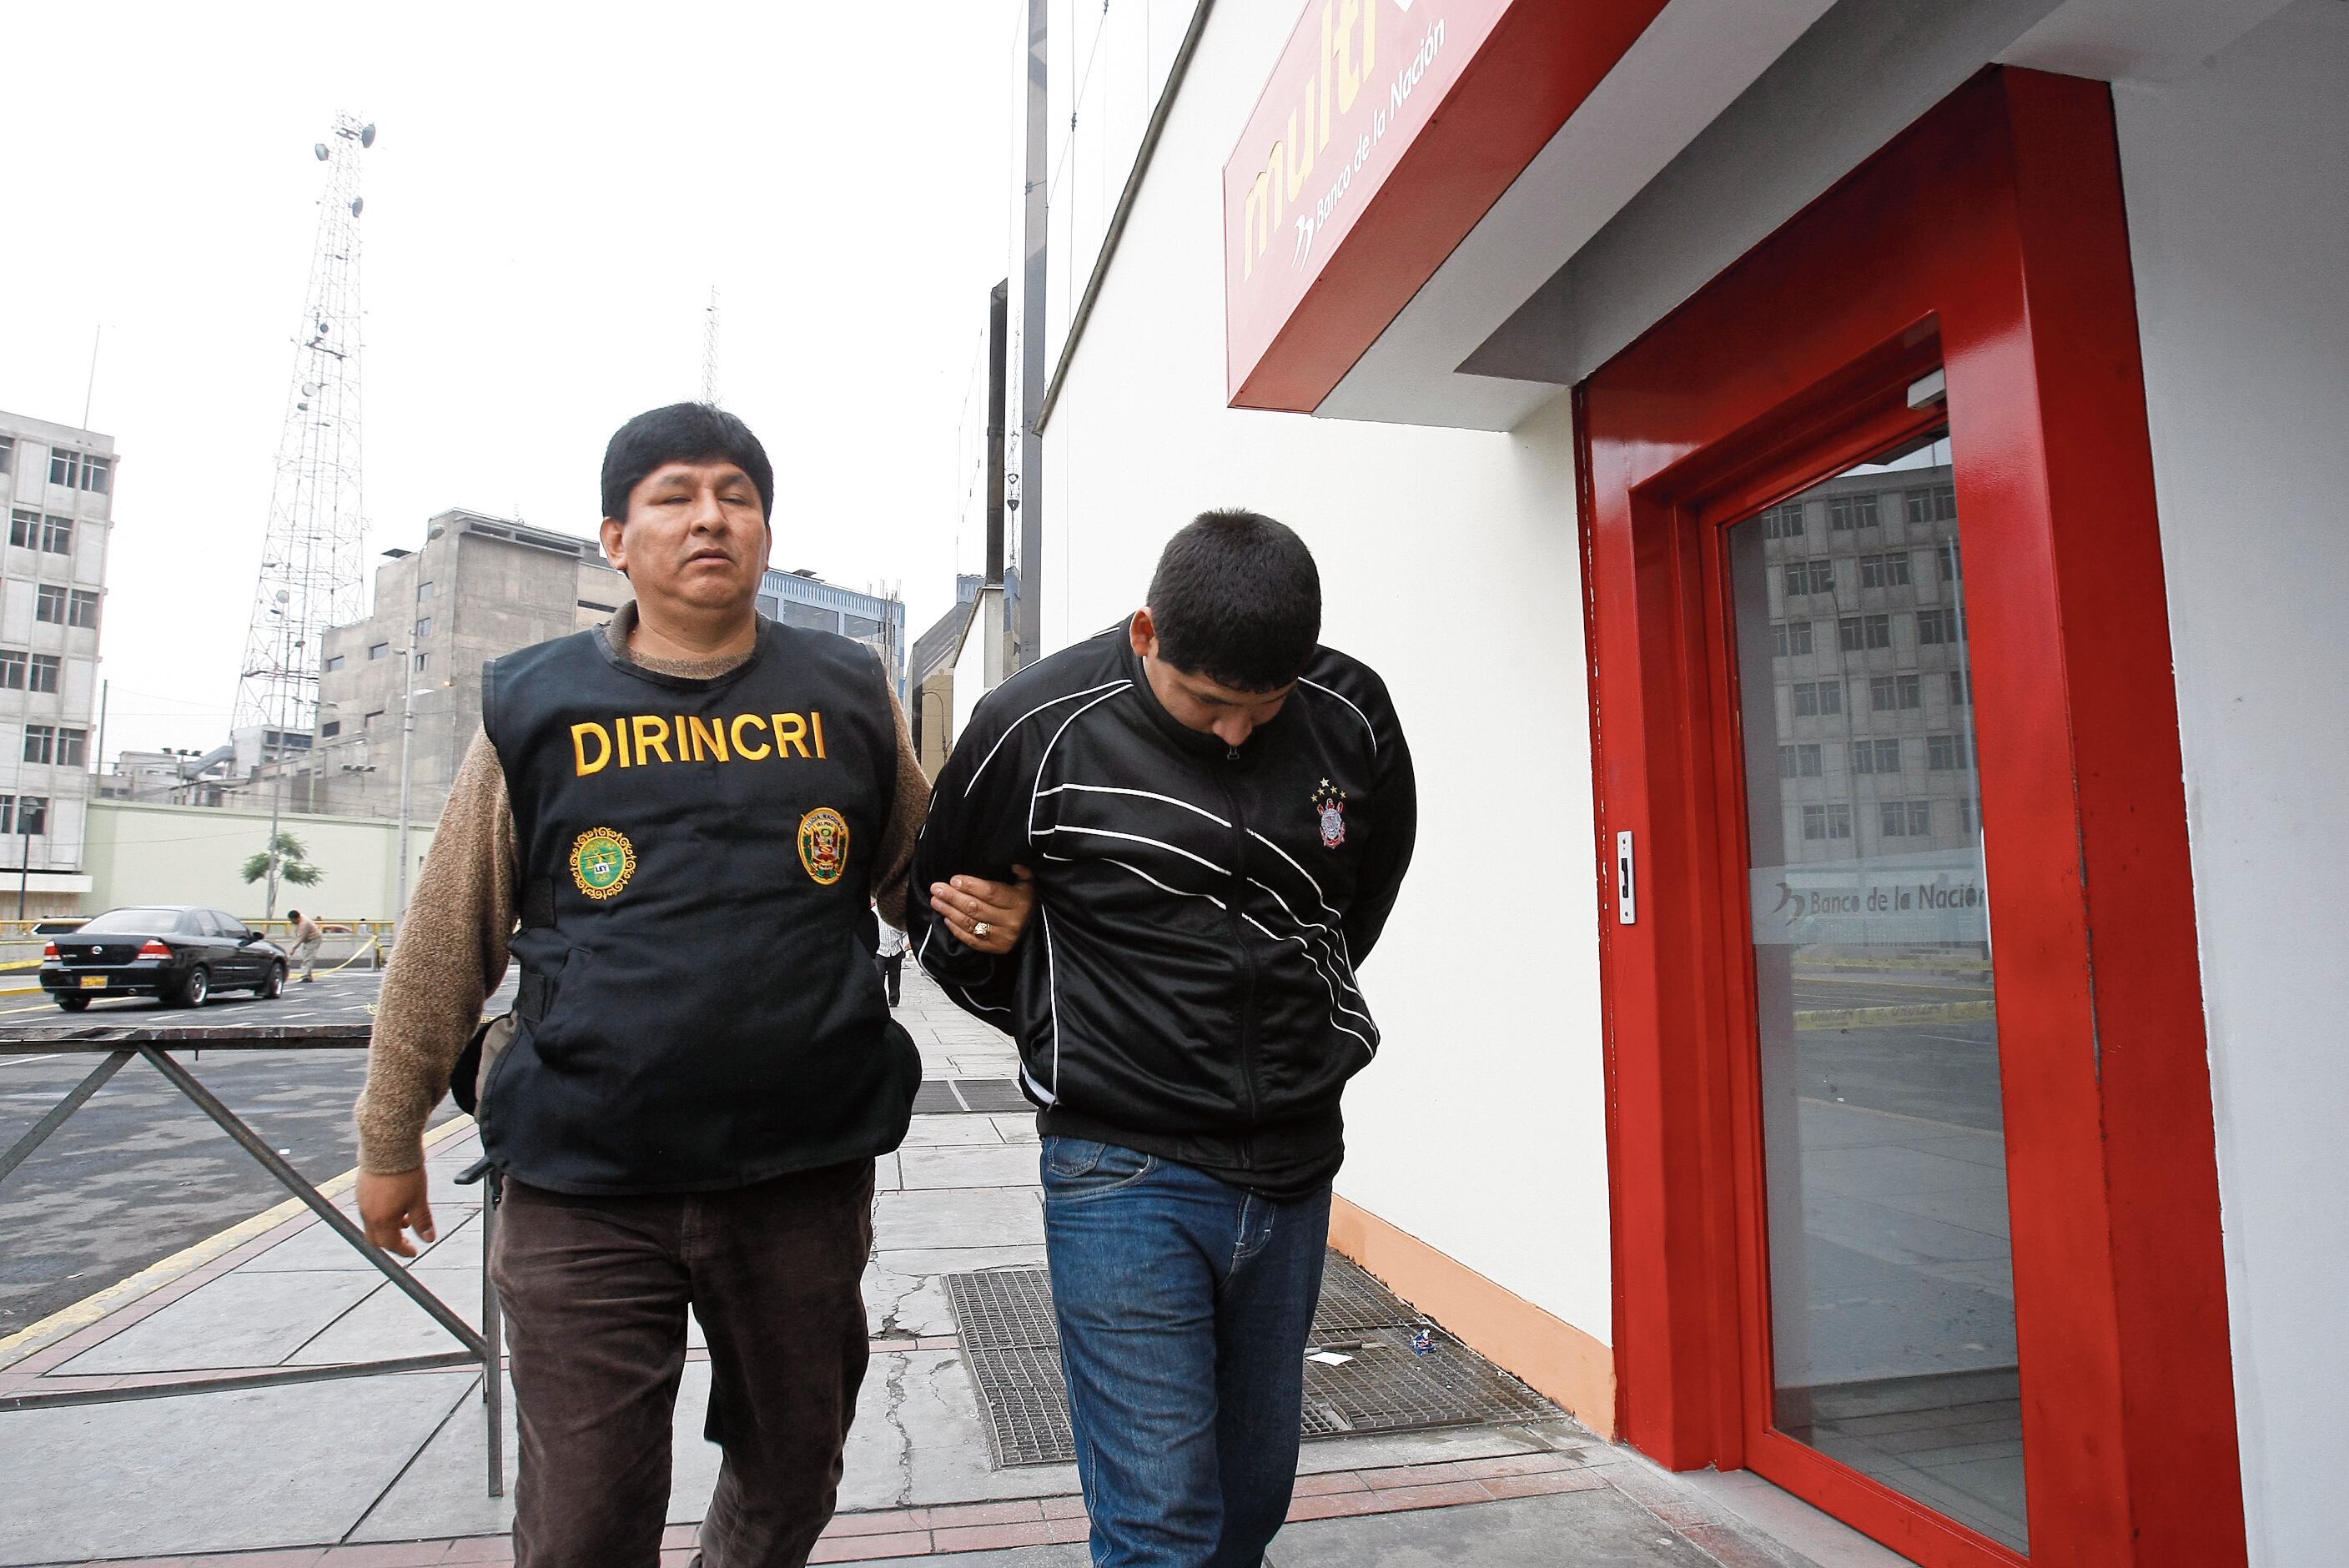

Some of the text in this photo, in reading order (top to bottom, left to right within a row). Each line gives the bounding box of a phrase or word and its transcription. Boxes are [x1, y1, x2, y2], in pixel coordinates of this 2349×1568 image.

[1316, 18, 1446, 233] Banco de la Nación
[570, 711, 827, 777] DIRINCRI
[1811, 892, 1860, 914] Banco
[1867, 887, 1888, 912] de
[1894, 886, 1910, 911] la
